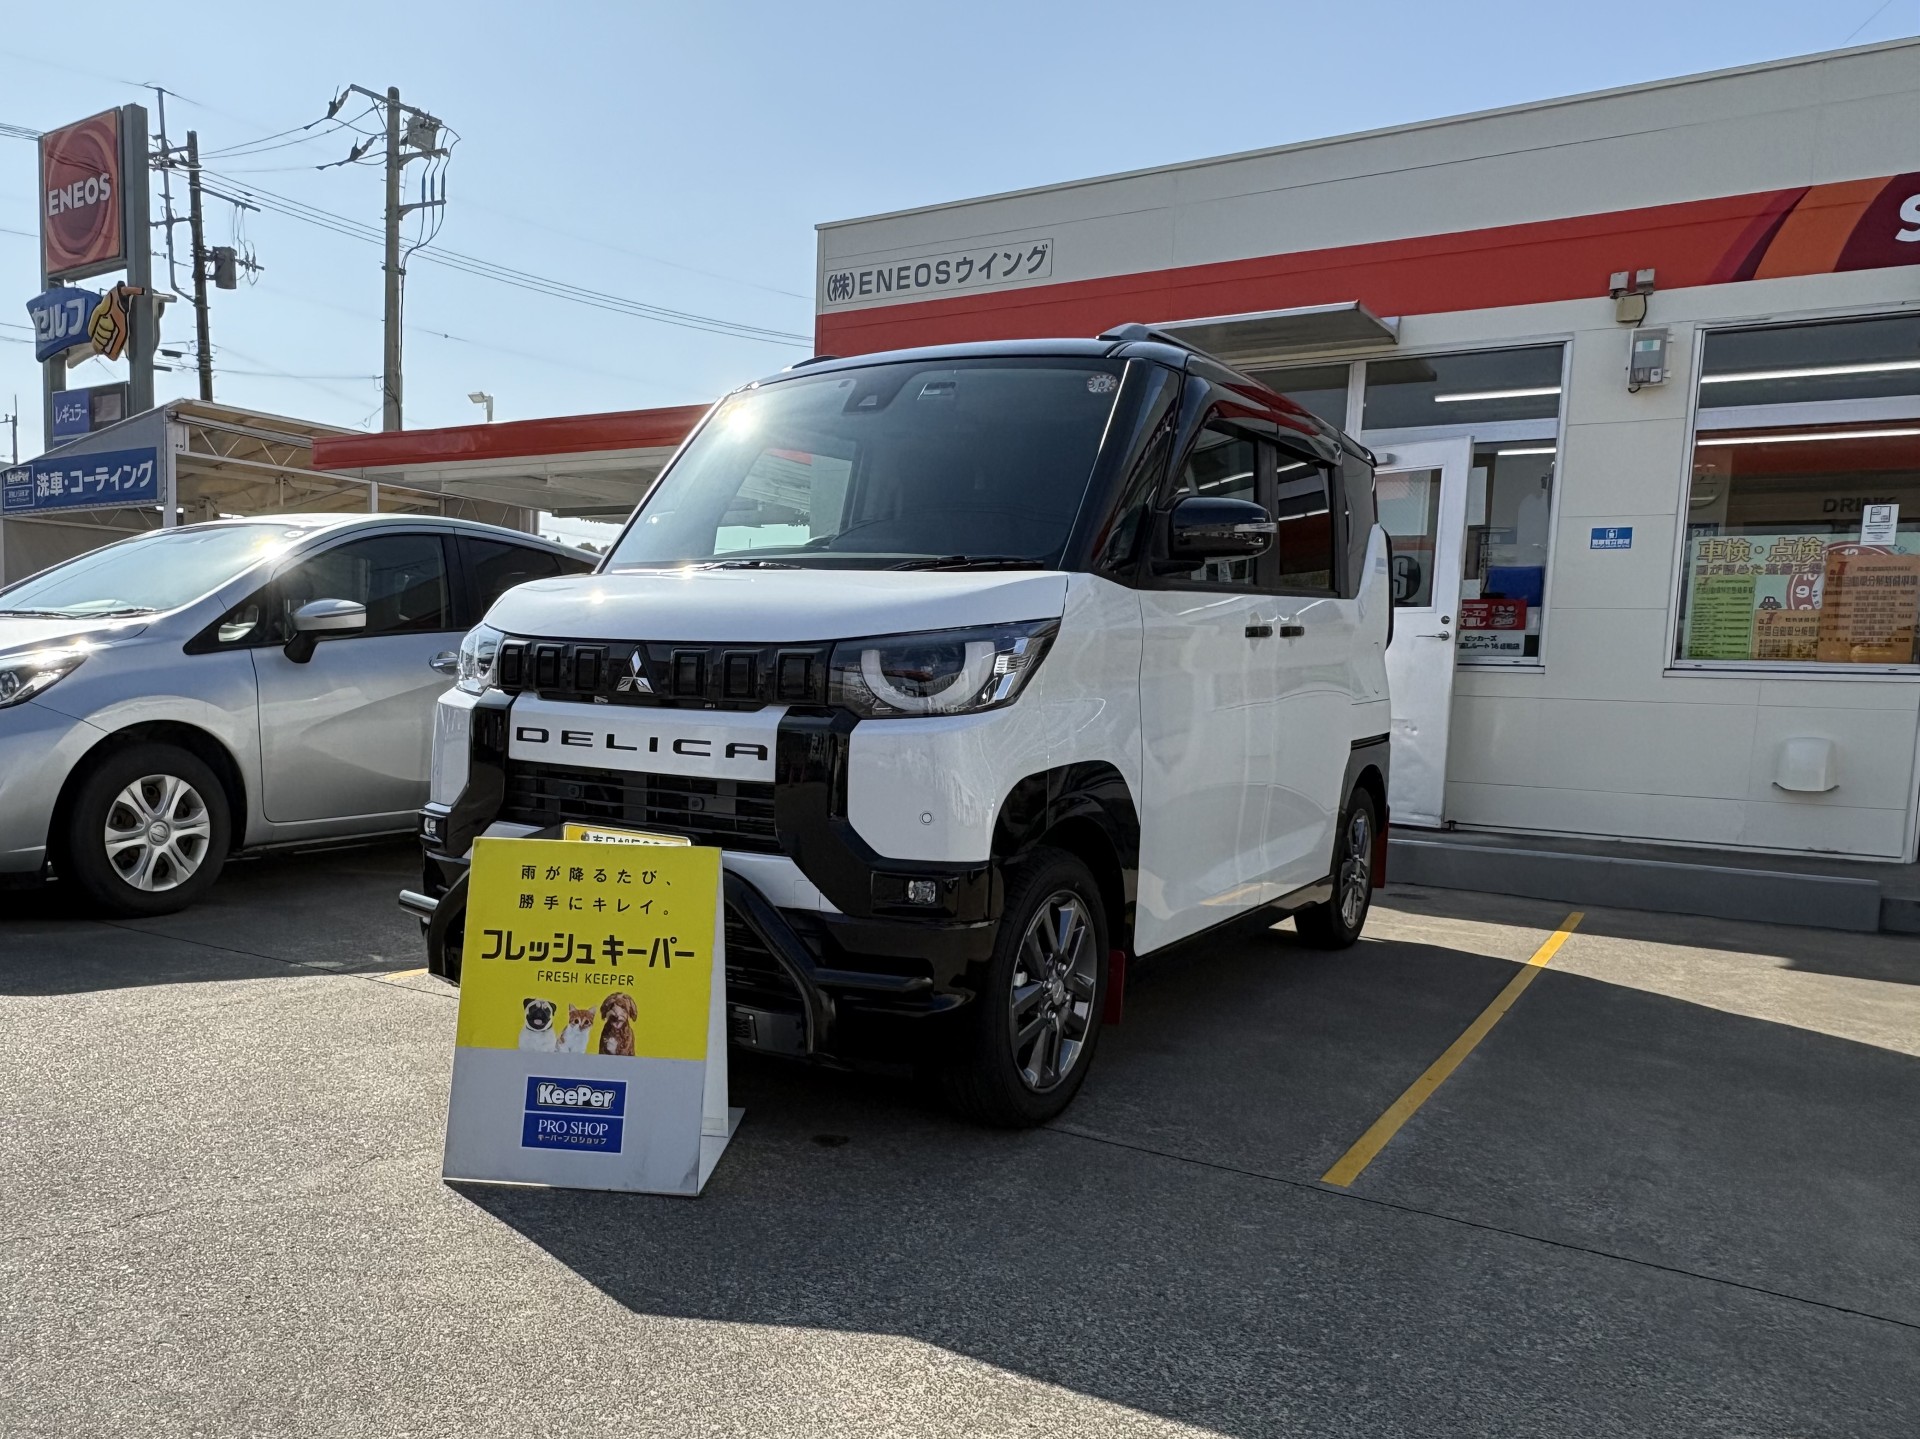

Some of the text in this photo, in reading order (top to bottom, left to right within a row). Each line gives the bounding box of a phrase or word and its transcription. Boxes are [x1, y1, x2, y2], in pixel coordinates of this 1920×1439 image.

[48, 173, 111, 216] ENEOS
[827, 243, 1048, 302] (株)ENEOSウイング
[32, 297, 86, 342] セルフ
[55, 404, 87, 423] レギュラー
[36, 460, 154, 497] 洗車・コーティング
[1697, 536, 1825, 563] 車検・点検
[516, 726, 769, 761] DELICA
[481, 929, 695, 969] フレッシュキーパー
[537, 970, 635, 986] FRESH KEEPER
[538, 1083, 615, 1108] KeePer
[538, 1119, 609, 1136] PRO SHOP
